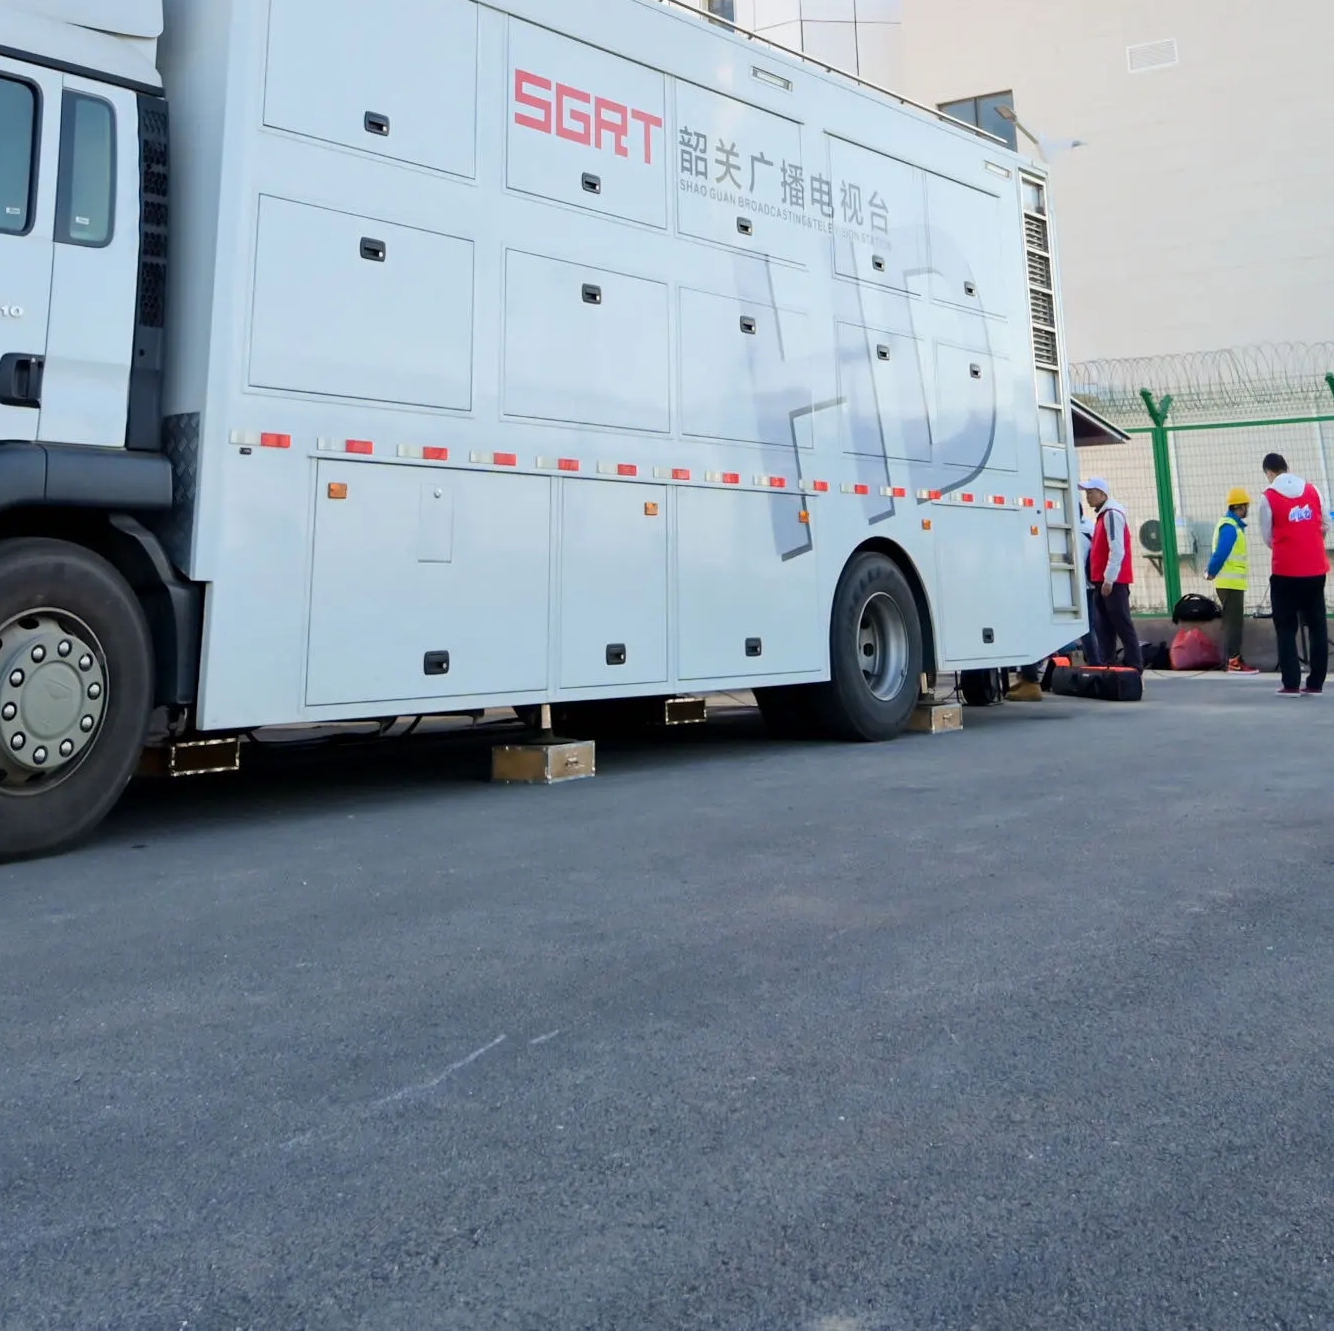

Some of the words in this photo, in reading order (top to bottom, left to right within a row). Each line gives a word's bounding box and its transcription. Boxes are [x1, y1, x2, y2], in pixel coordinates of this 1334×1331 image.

[515, 68, 663, 165] SGRT
[679, 125, 890, 236] 韶关广播电视台
[679, 178, 708, 197] SHAO
[709, 187, 736, 204] GUAN
